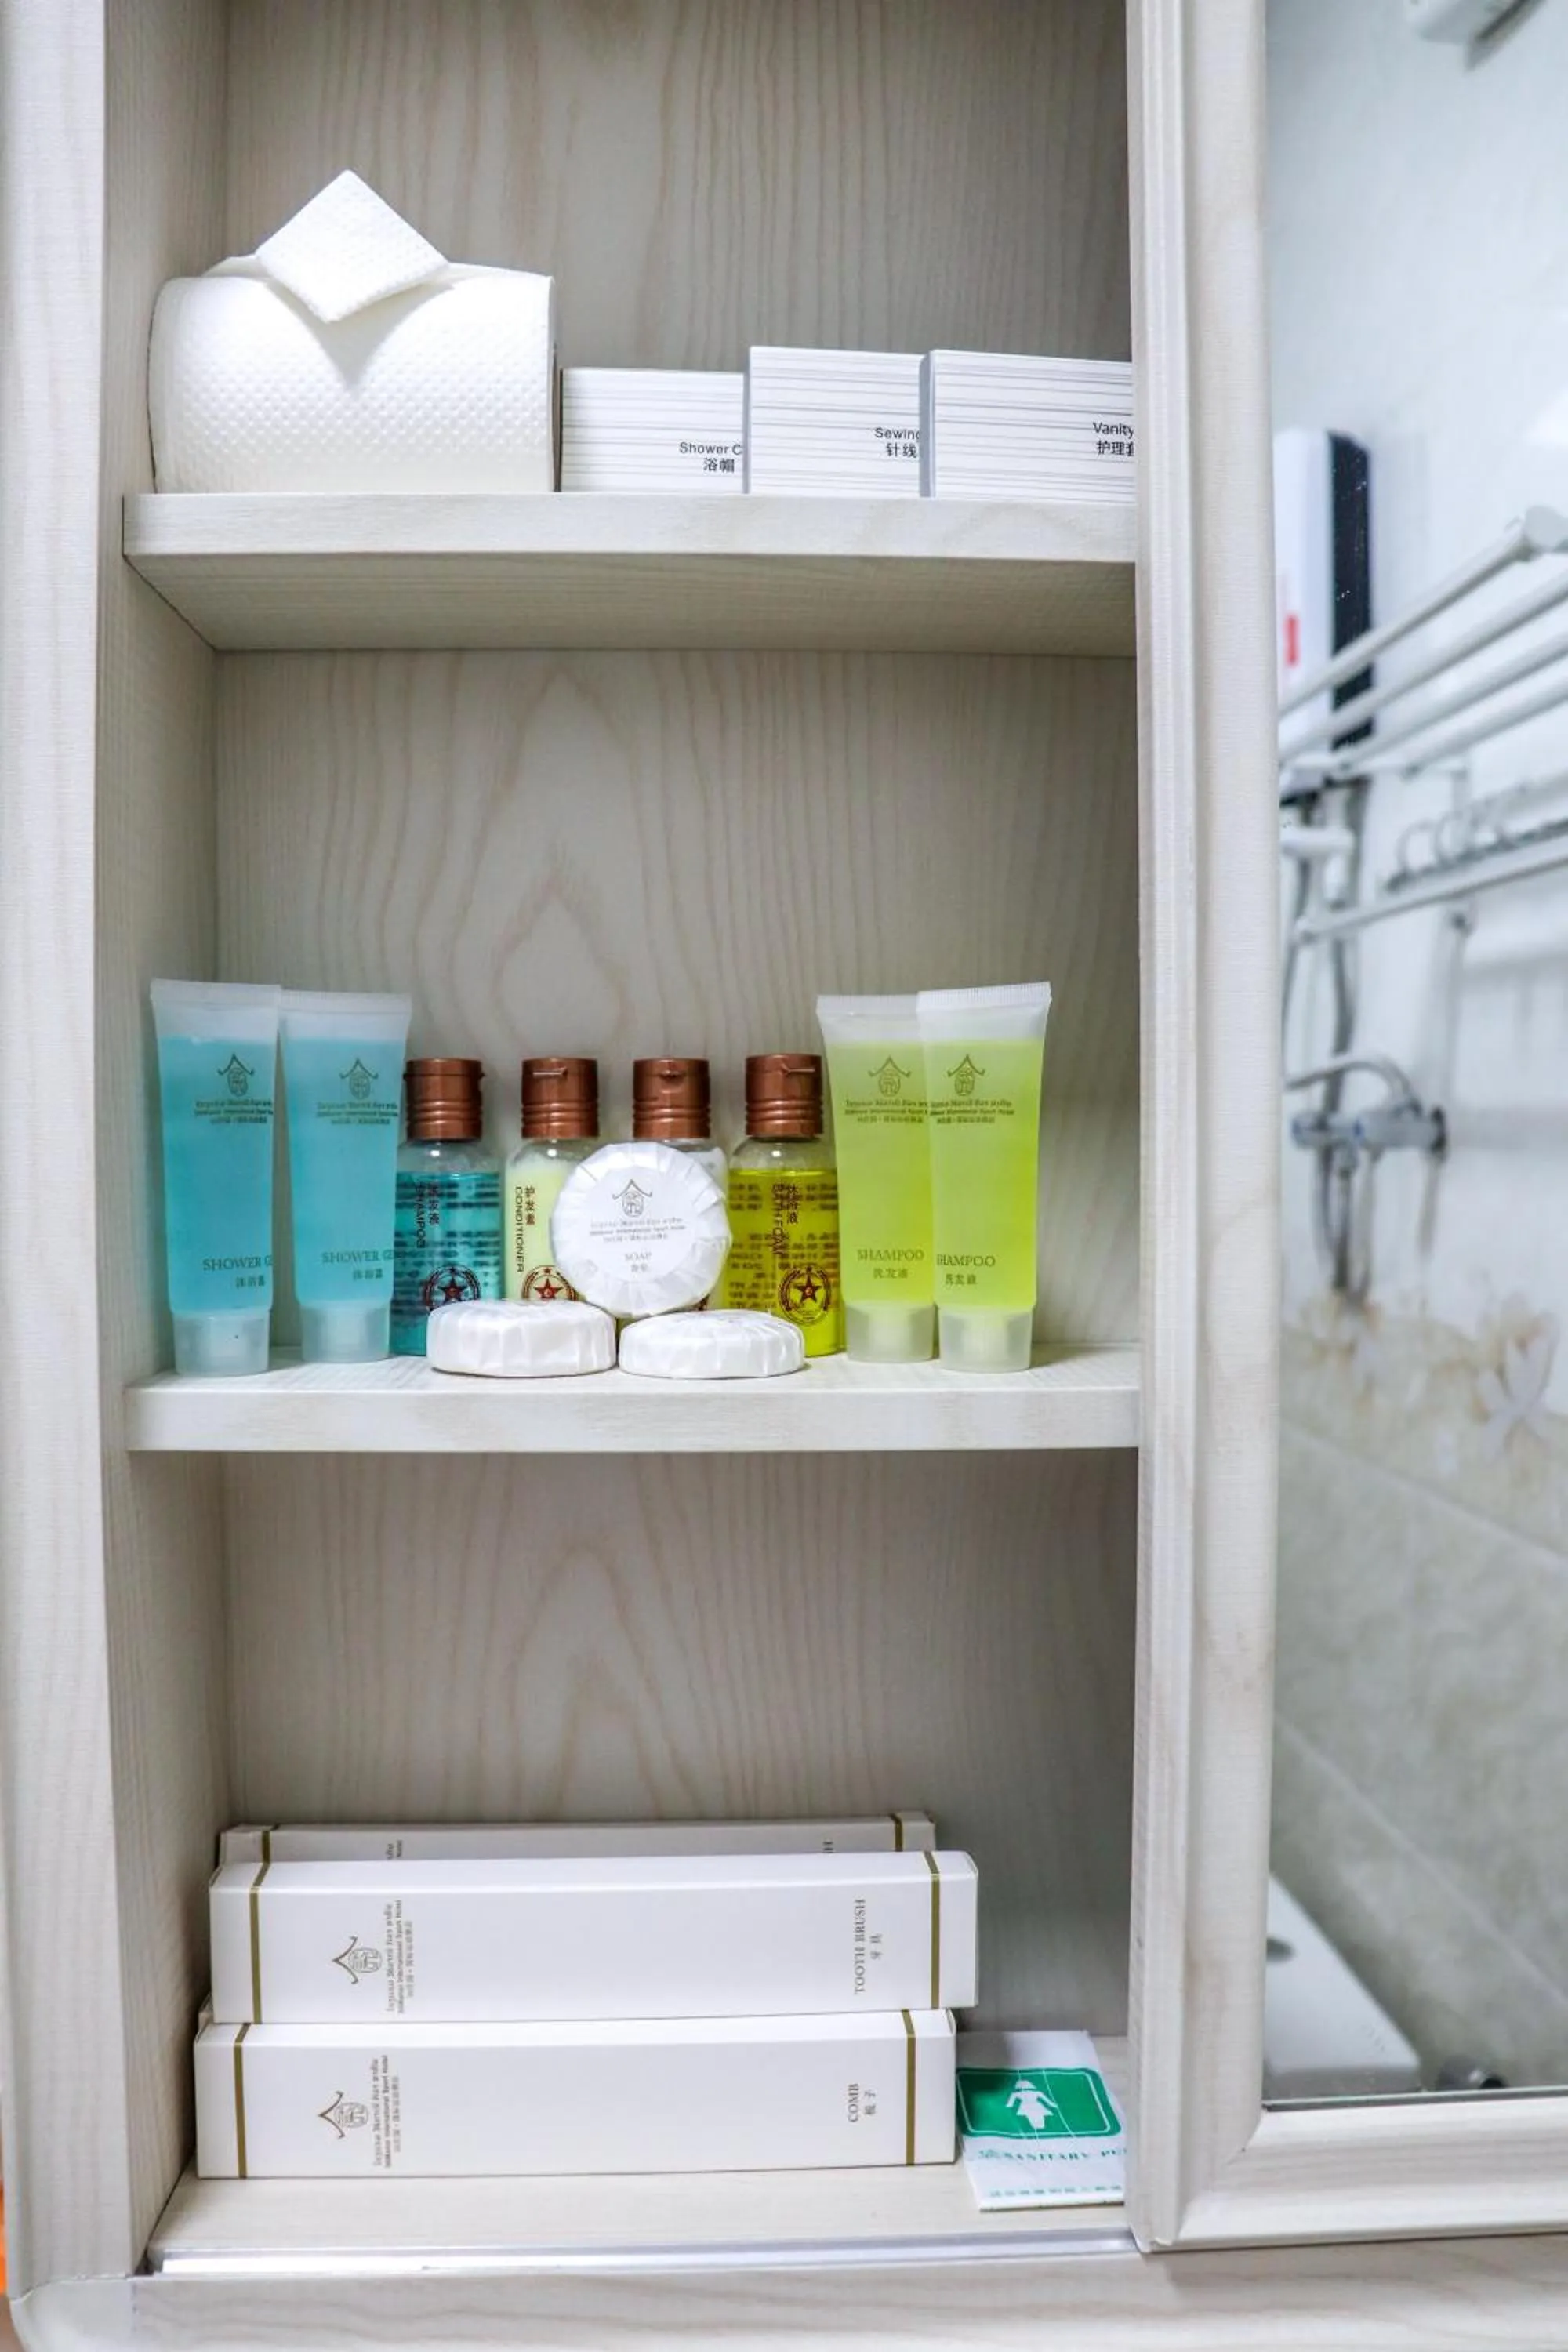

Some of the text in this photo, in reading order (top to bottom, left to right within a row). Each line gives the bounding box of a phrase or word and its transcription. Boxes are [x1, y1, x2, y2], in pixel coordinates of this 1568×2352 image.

[1092, 421, 1134, 440] Vanity
[679, 441, 730, 454] Shower
[515, 1186, 524, 1272] CONDITIONER
[202, 1255, 262, 1272] SHOWER
[321, 1250, 379, 1264] SHOWER
[857, 1249, 925, 1262] SHAMPOO
[853, 1899, 866, 1995] TOOTH BRUSH
[848, 2083, 859, 2123] COMB
